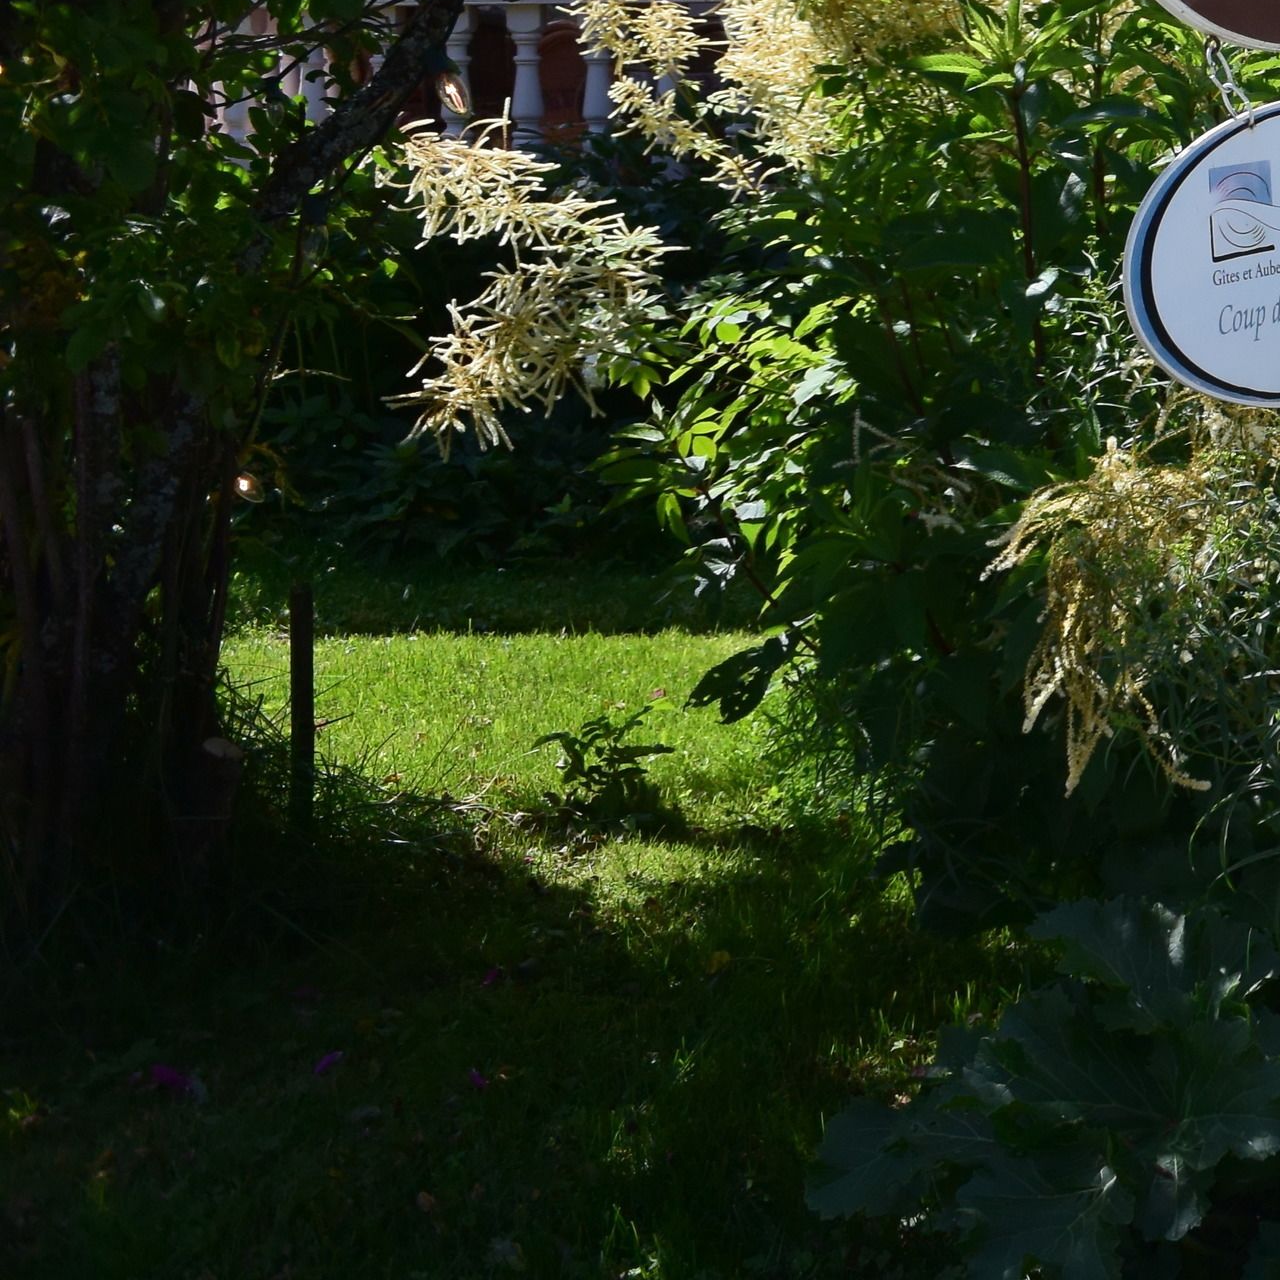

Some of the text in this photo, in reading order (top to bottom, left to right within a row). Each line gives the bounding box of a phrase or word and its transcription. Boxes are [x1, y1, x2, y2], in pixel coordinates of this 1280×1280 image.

[1212, 270, 1240, 286] Gîtes
[1243, 271, 1252, 281] et
[1219, 304, 1265, 341] Coup
